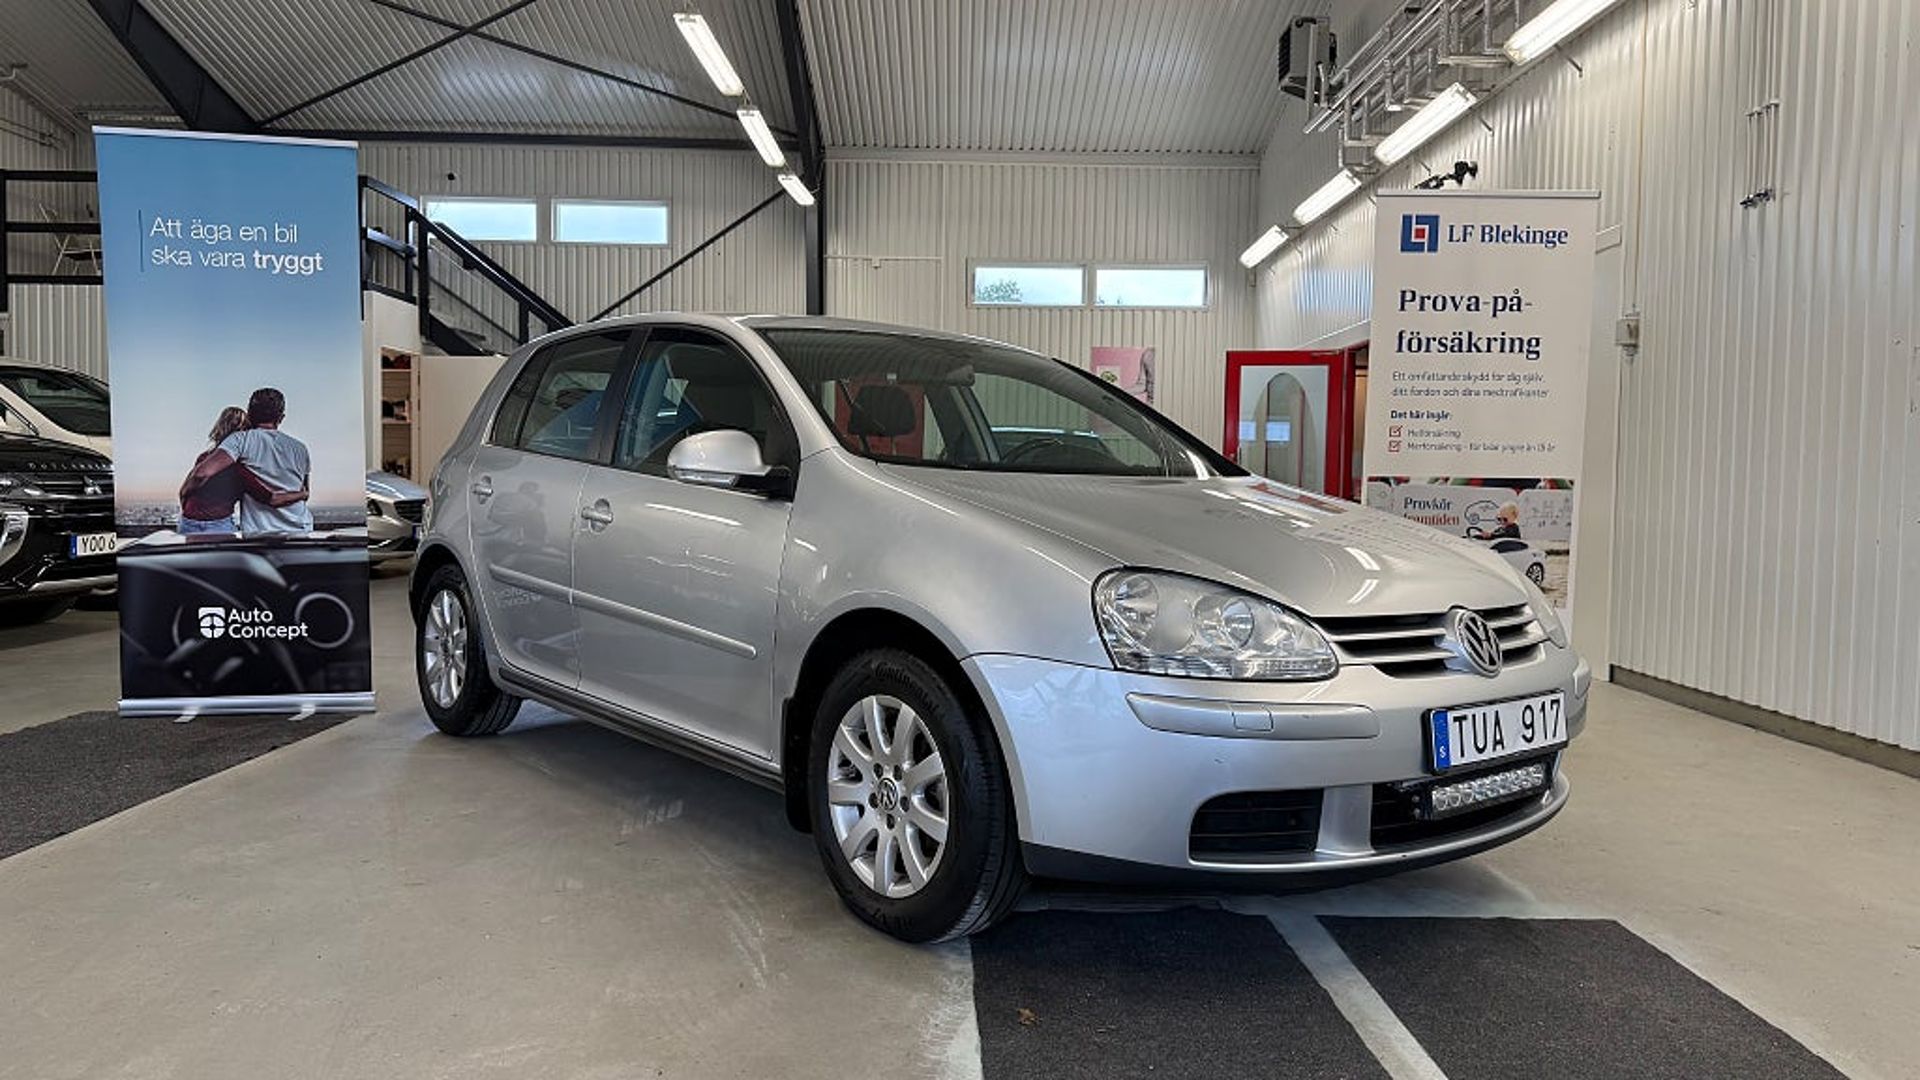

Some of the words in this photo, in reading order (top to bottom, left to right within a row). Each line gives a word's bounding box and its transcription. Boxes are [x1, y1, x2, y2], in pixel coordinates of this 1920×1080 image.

[150, 217, 182, 239] Att
[190, 219, 232, 245] äga
[239, 225, 267, 242] en
[274, 222, 298, 244] bil
[1448, 225, 1474, 242] LF
[1480, 225, 1568, 248] Blekinge
[151, 246, 192, 266] ska
[198, 252, 245, 269] vara
[253, 251, 324, 275] tryggt
[1398, 288, 1532, 317] Prova-på-
[1396, 330, 1541, 361] försäkring
[1390, 410, 1407, 420] Det
[1409, 410, 1424, 420] här
[1403, 496, 1452, 510] Provkör
[228, 608, 273, 623] Auto
[228, 622, 308, 640] Concept
[1452, 709, 1505, 758] TUA
[1521, 698, 1561, 743] 917
